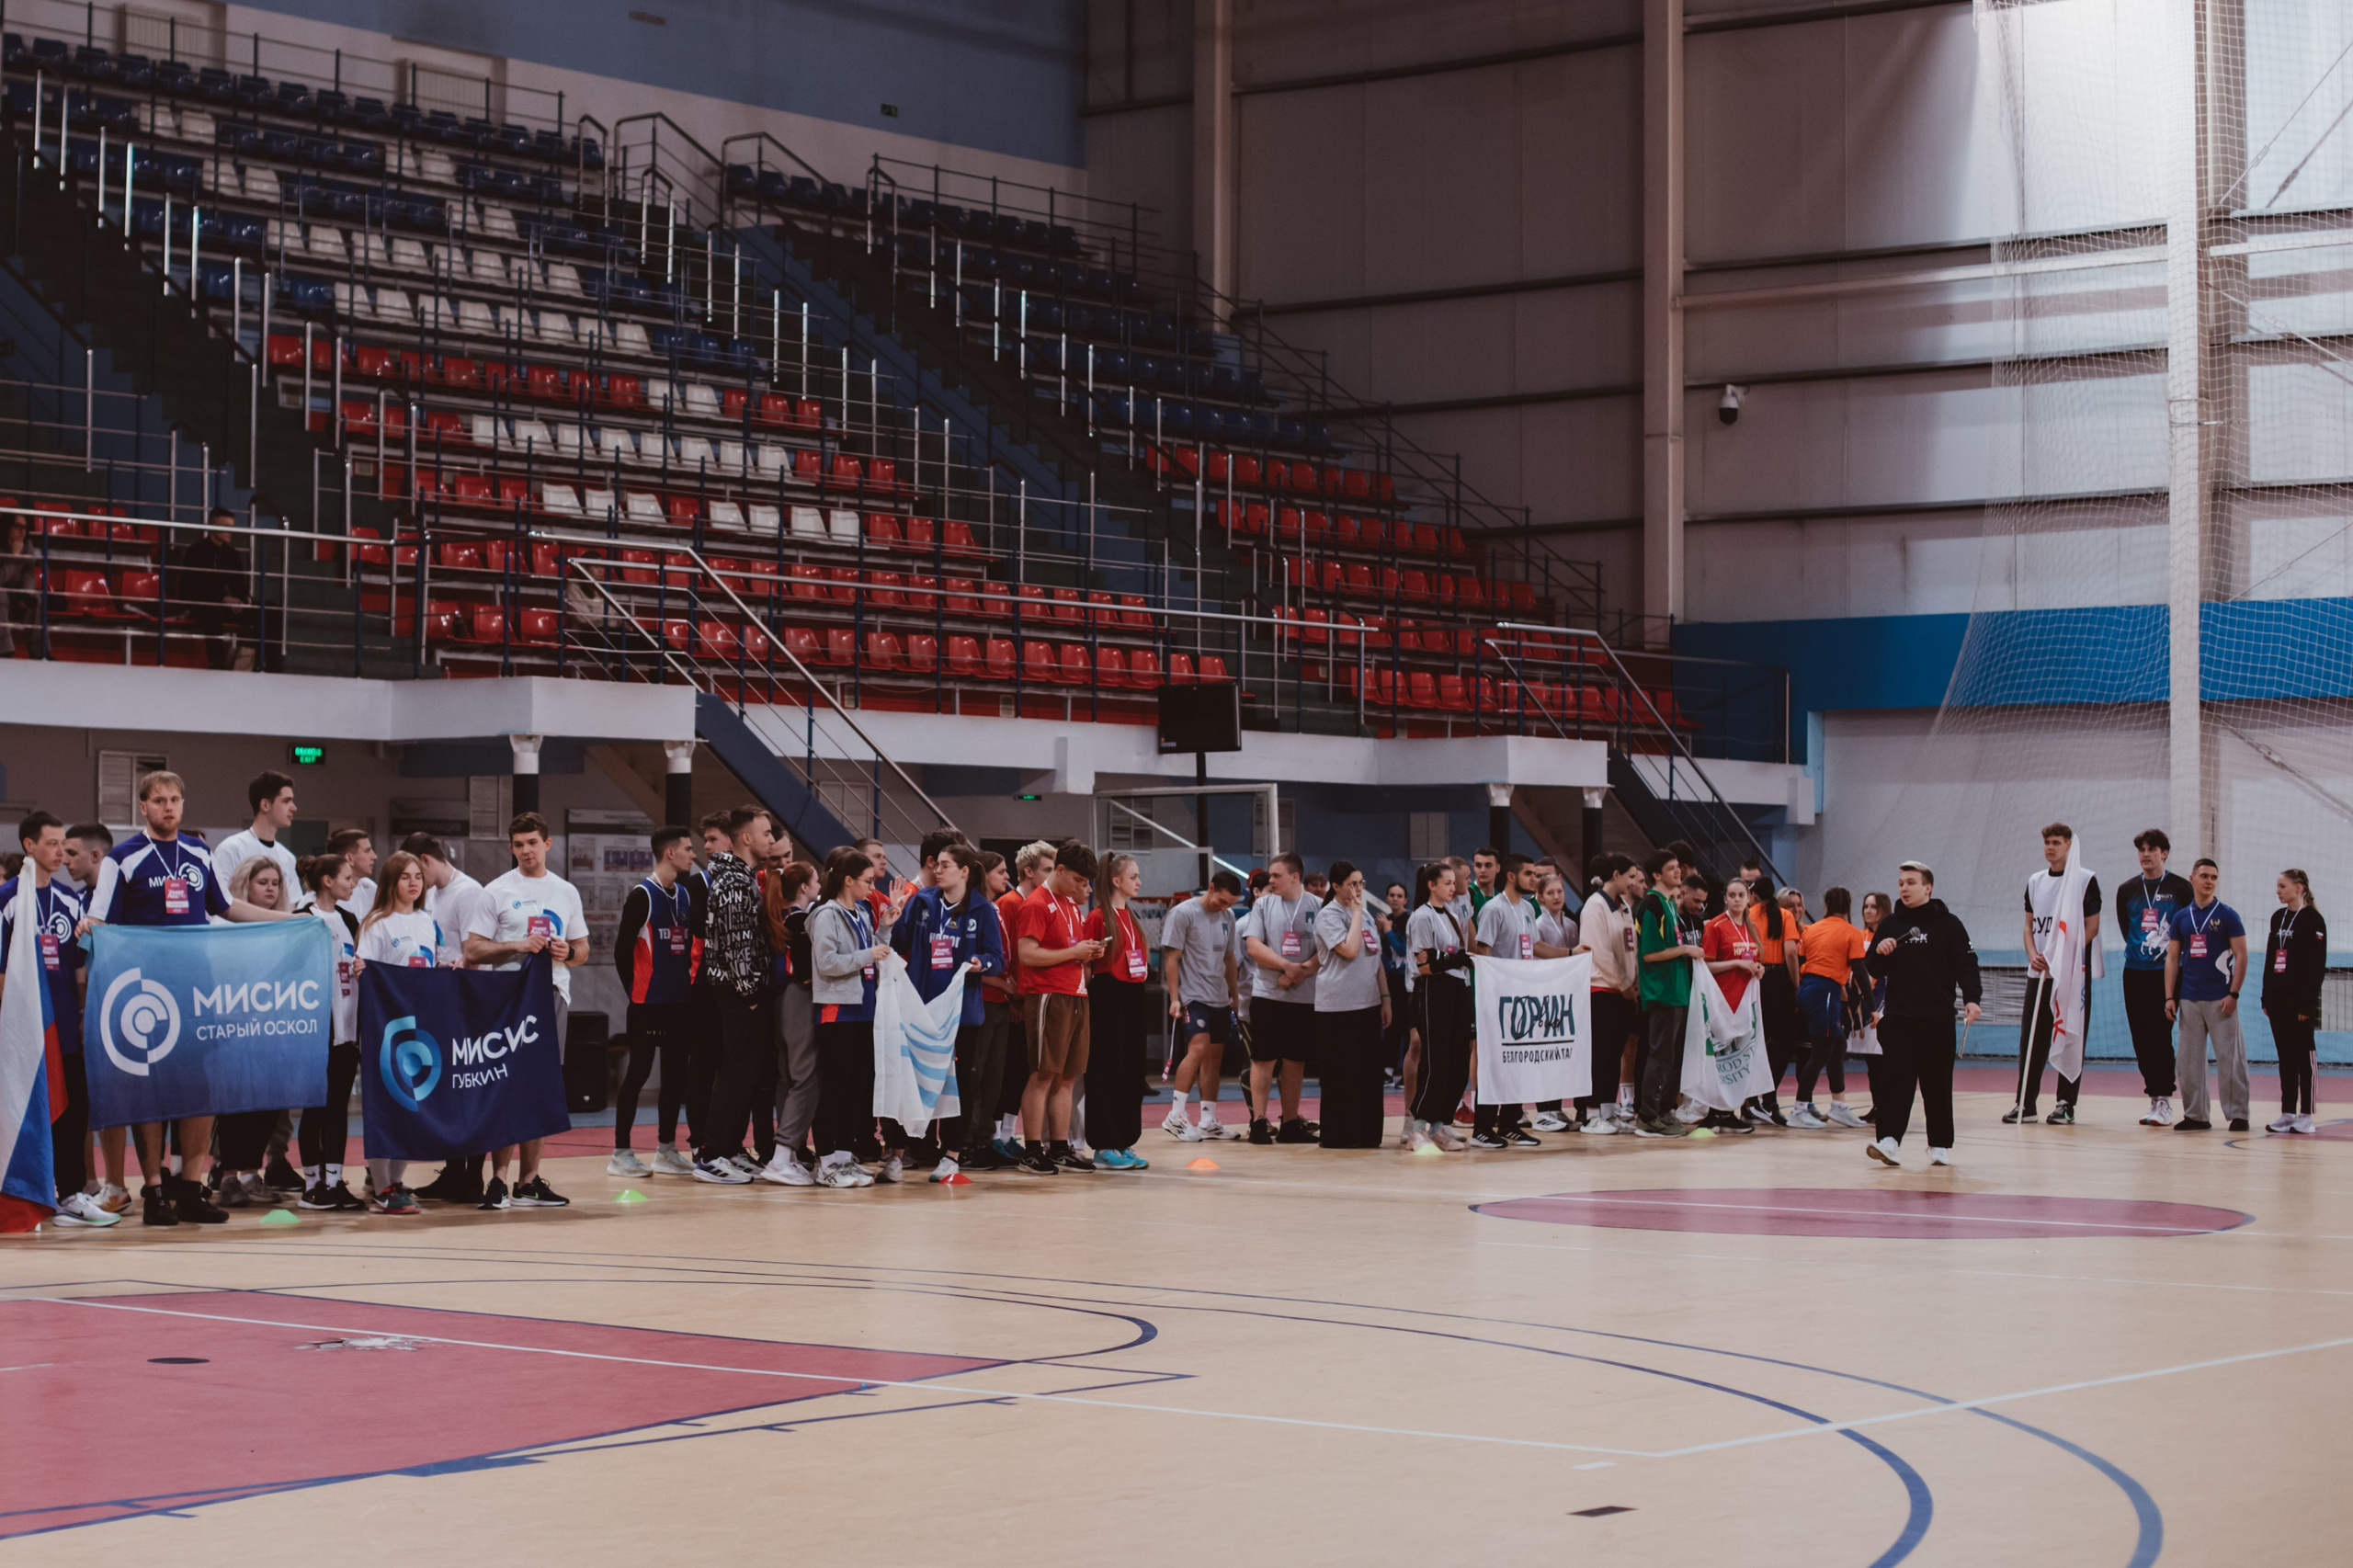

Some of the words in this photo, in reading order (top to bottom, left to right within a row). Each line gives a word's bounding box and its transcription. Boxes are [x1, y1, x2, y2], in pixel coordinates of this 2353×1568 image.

[192, 979, 320, 1017] МИСИС
[196, 1017, 261, 1041] СТАРЫЙ
[264, 1018, 318, 1036] ОСКОЛ
[1498, 993, 1575, 1040] ГОРИН
[452, 1014, 540, 1067] МИСИС
[1502, 1046, 1561, 1064] БЕЛГОРОДСКИЙ
[452, 1062, 508, 1089] ГУБКИН
